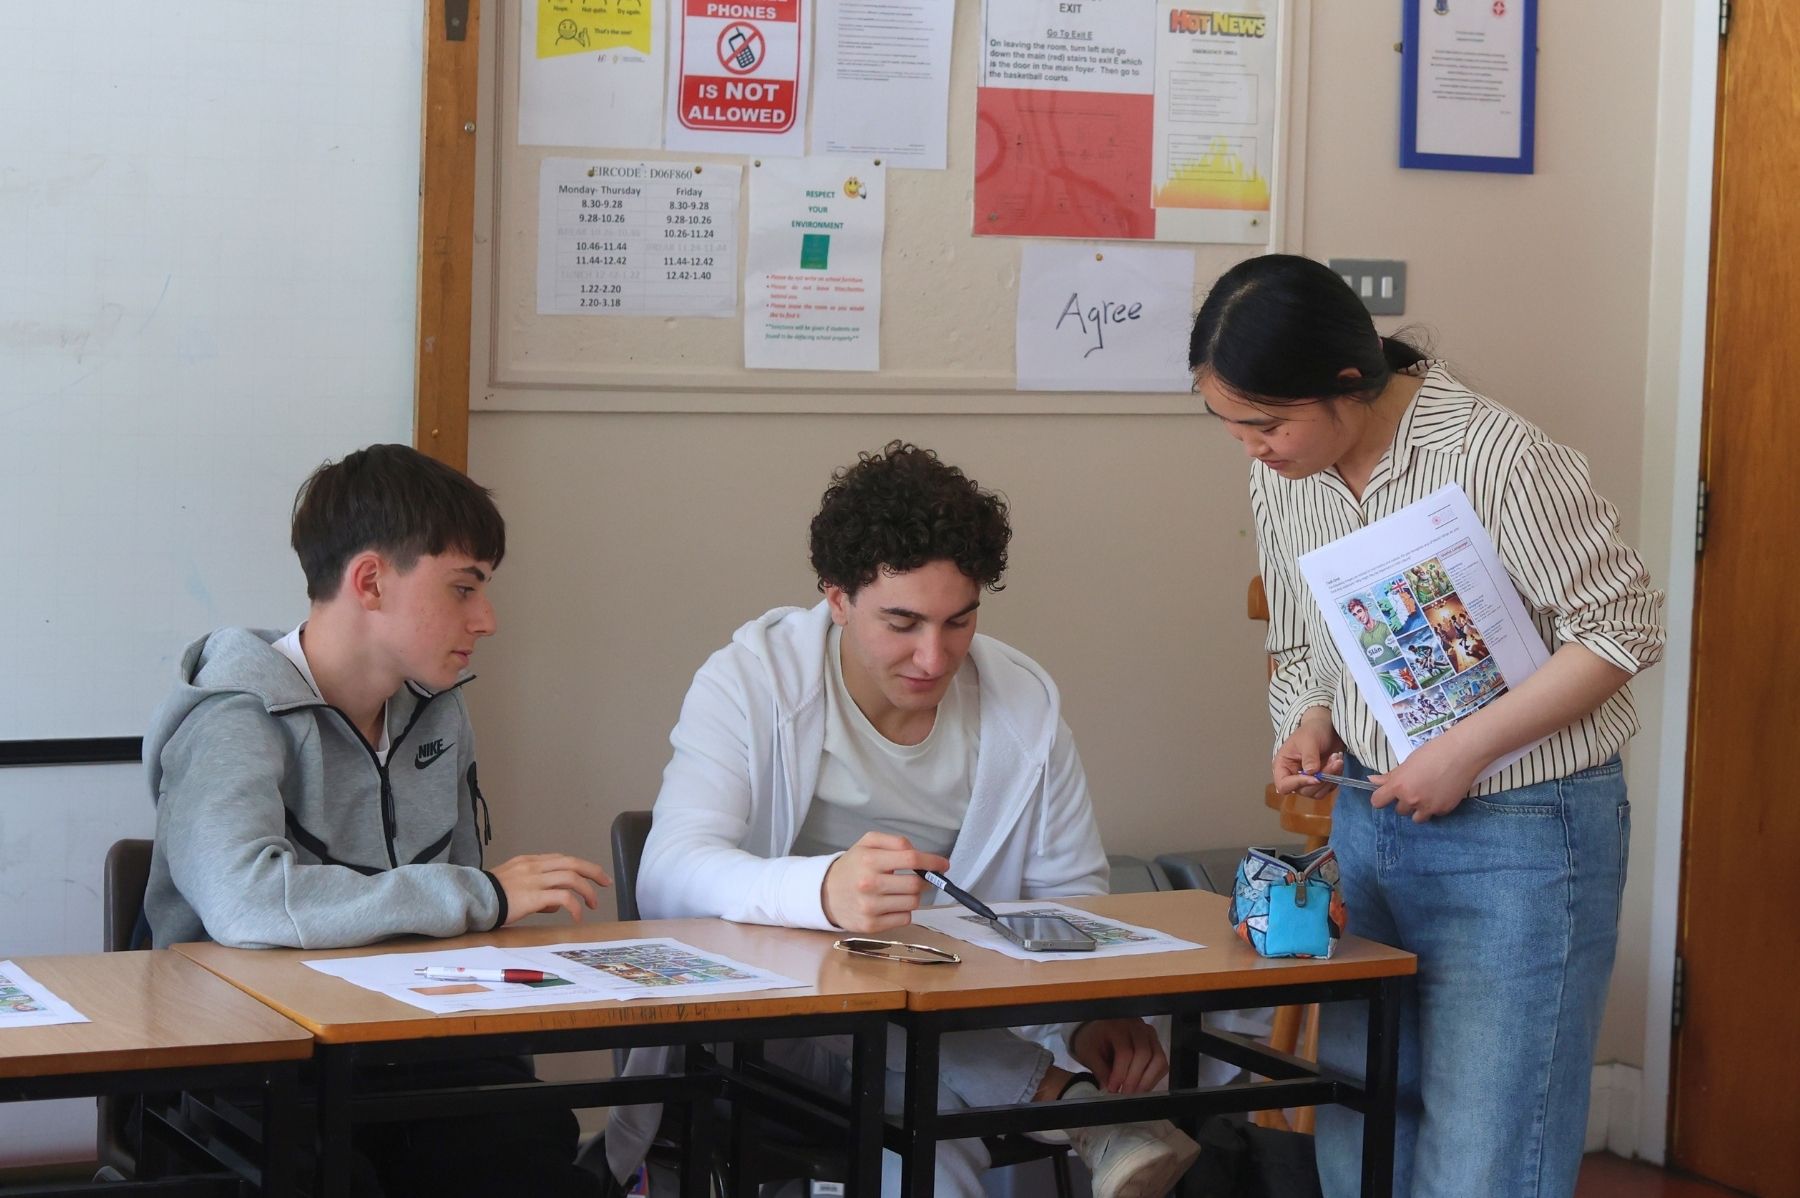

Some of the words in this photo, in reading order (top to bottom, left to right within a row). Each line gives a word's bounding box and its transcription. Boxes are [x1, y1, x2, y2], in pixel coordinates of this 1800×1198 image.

[707, 3, 776, 19] PHONES
[1059, 3, 1082, 13] EXIT
[1047, 29, 1058, 38] Go
[1071, 30, 1086, 39] Exit
[990, 39, 1001, 47] On
[1004, 40, 1031, 50] leaving
[1088, 45, 1099, 53] left
[1117, 48, 1126, 56] go
[990, 50, 1011, 58] down
[1048, 54, 1065, 62] (red)
[1099, 56, 1112, 64] exit
[989, 70, 1001, 78] the
[1004, 71, 1042, 80] basketball
[1101, 66, 1119, 75] Then
[1120, 68, 1130, 76] go
[1132, 68, 1139, 76] to
[698, 84, 718, 99] IS
[725, 82, 780, 102] NOT
[688, 105, 786, 124] ALLOWED
[592, 166, 641, 178] EIRCODE
[601, 186, 641, 196] Thursday
[676, 187, 703, 197] Friday
[806, 190, 835, 199] RESPECT
[582, 199, 623, 208] 8.30-9.28
[669, 201, 709, 210] 8.30-9.28
[579, 214, 625, 223] 9.28-10.26
[666, 215, 712, 225] 9.28-10.26
[791, 220, 844, 229] ENVIRONMENT
[664, 229, 714, 238] 10.26-11.24
[576, 242, 627, 251] 10.46-11.44
[576, 256, 626, 265] 11.44-12.42
[664, 257, 713, 266] 11.44-12.42
[666, 271, 711, 280] 12.42-1.40
[580, 284, 621, 293] 1.22-2.20
[580, 298, 621, 307] 2.20-3.18
[1056, 293, 1143, 358] Agree
[419, 738, 443, 758] NIKE
